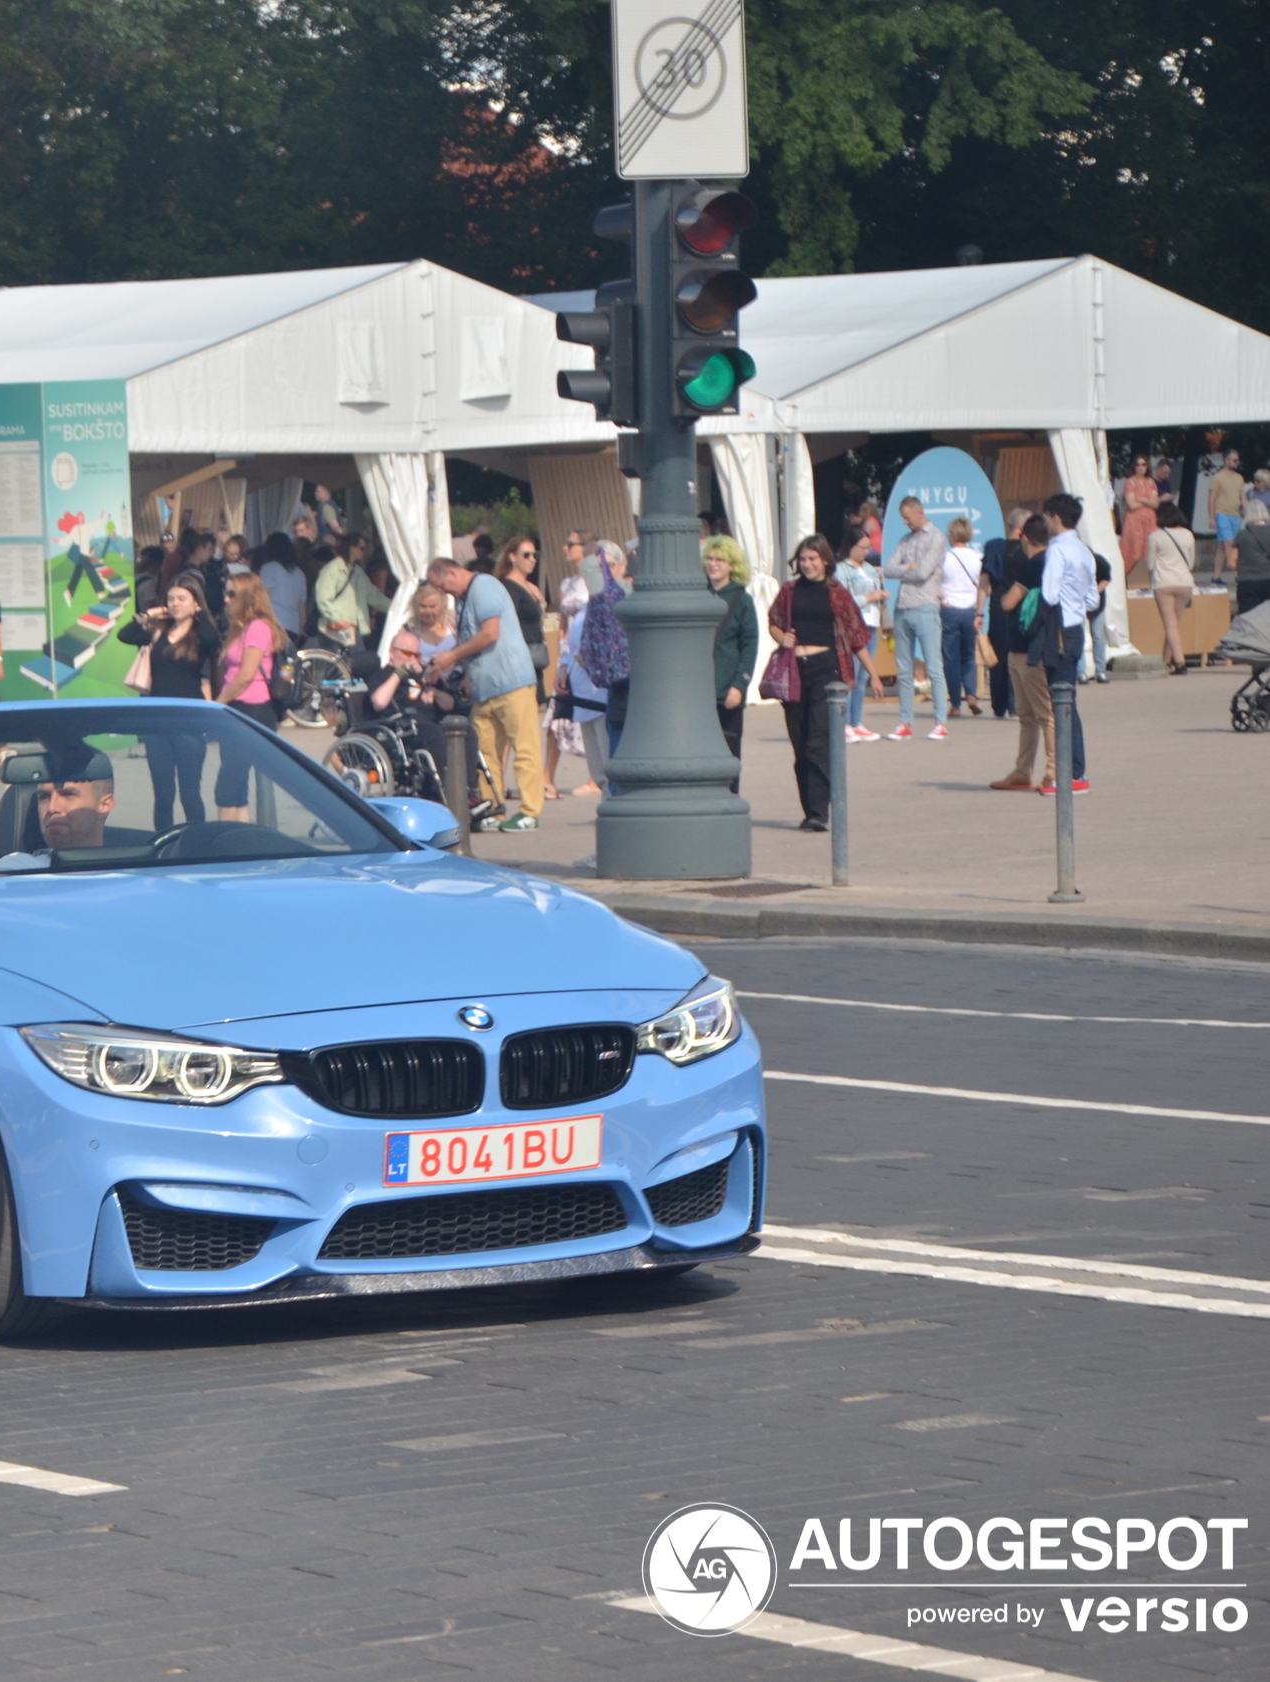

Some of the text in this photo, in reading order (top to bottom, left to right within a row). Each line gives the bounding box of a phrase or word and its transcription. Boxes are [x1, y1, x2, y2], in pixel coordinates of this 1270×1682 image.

[655, 48, 707, 90] 30
[48, 401, 125, 418] SUSITINKAM
[63, 418, 125, 441] BOKŠTO
[420, 1125, 575, 1177] 8041BU
[388, 1163, 407, 1175] LT
